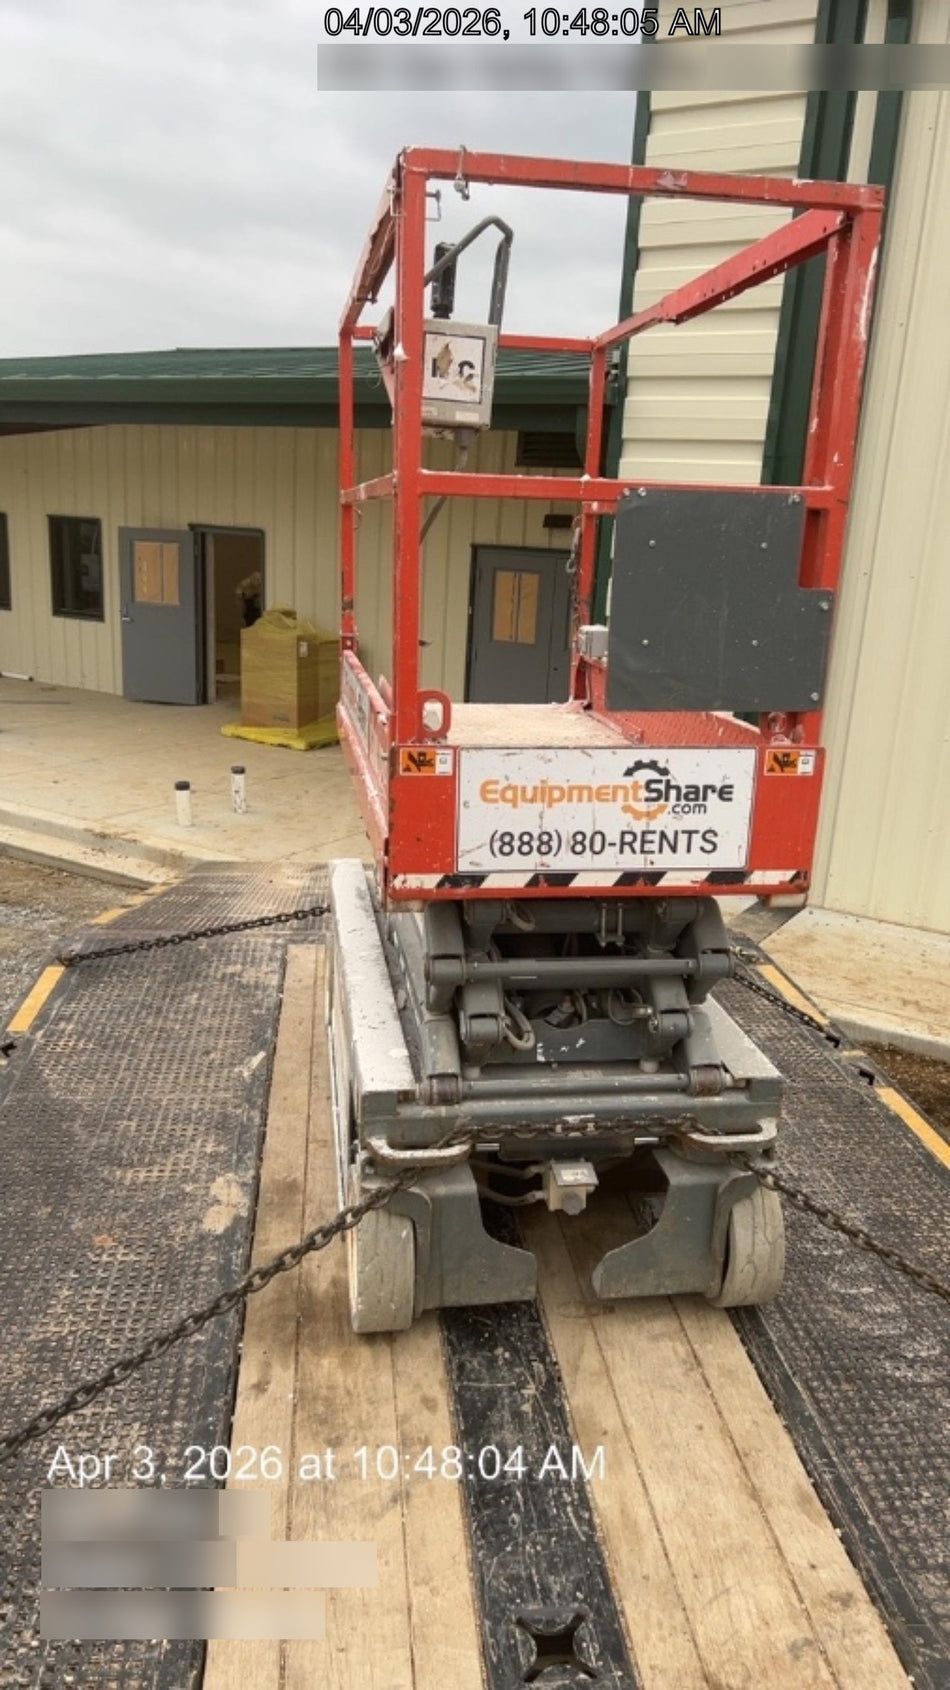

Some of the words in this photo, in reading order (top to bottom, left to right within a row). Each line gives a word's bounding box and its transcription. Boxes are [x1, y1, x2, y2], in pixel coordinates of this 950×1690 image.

[479, 777, 735, 809] EquipmentShare
[667, 802, 708, 815] .com
[489, 829, 562, 858] (888)
[570, 828, 719, 856] 80-RENTS
